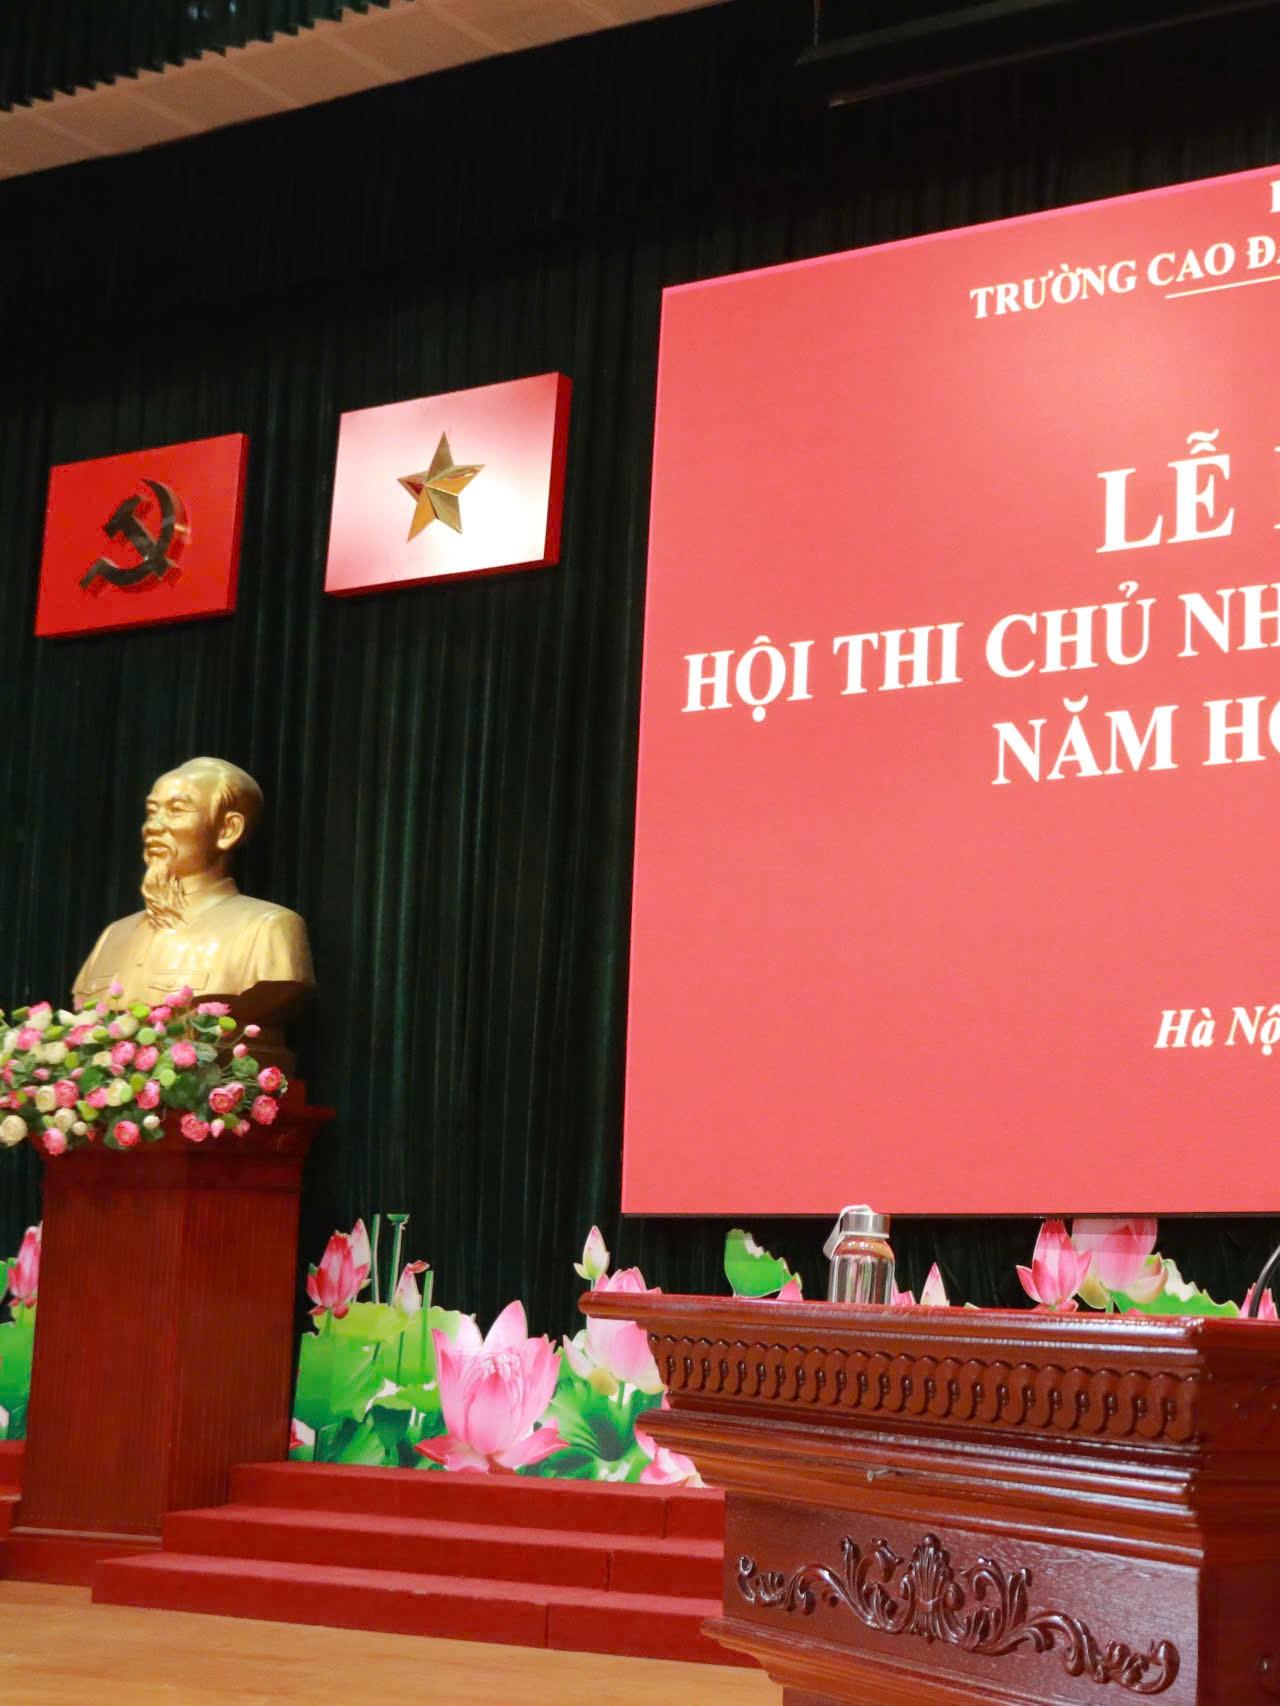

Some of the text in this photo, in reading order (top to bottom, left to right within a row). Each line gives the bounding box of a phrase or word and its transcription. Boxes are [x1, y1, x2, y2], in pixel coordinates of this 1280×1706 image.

[969, 260, 1137, 319] TRƯỜNG
[1147, 242, 1236, 286] CAO
[1096, 428, 1234, 553] LỄ
[681, 635, 815, 723] HỘI
[832, 622, 963, 698] THI
[985, 581, 1156, 678] CHỦ
[991, 695, 1179, 785] NĂM
[1153, 1006, 1216, 1049] Hà
